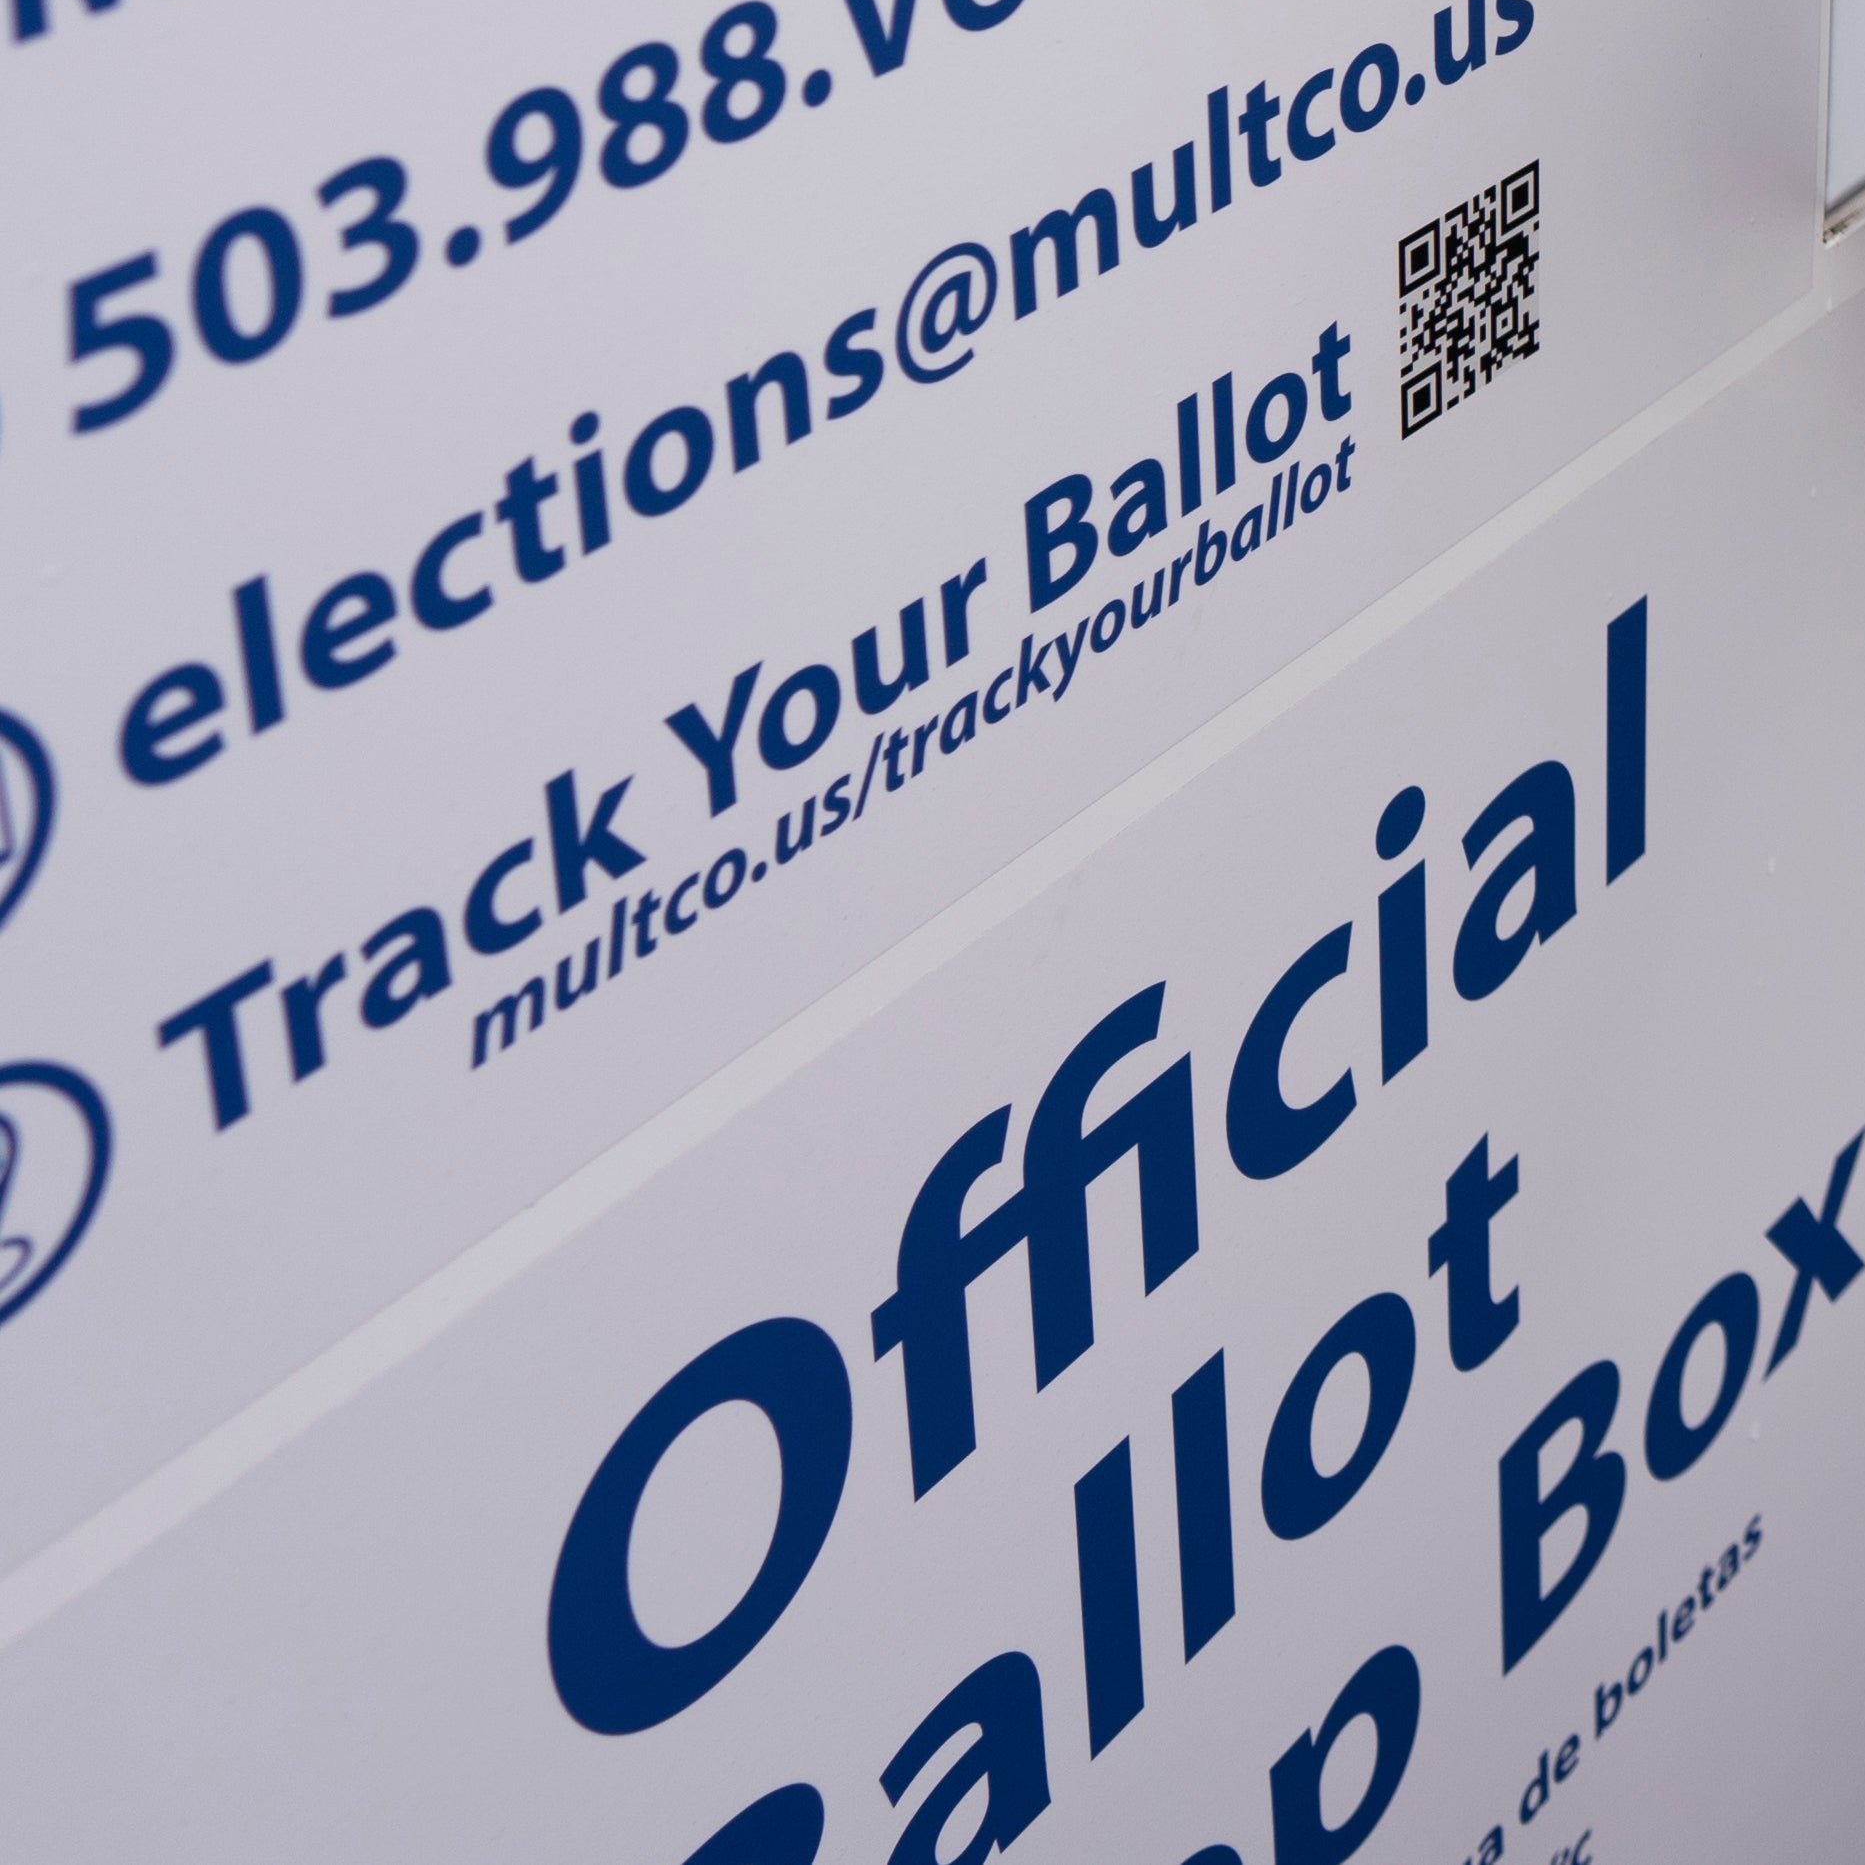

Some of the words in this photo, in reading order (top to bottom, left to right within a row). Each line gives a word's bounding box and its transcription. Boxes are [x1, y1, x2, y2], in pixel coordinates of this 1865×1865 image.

[156, 768, 647, 1133] Track
[662, 556, 986, 819] Your
[1025, 319, 1351, 613] Ballot
[470, 435, 1356, 1071] multco.us/trackyourballot
[547, 594, 1646, 1735] Official
[1519, 1731, 1580, 1825] de
[1594, 1512, 1763, 1739] boletas
